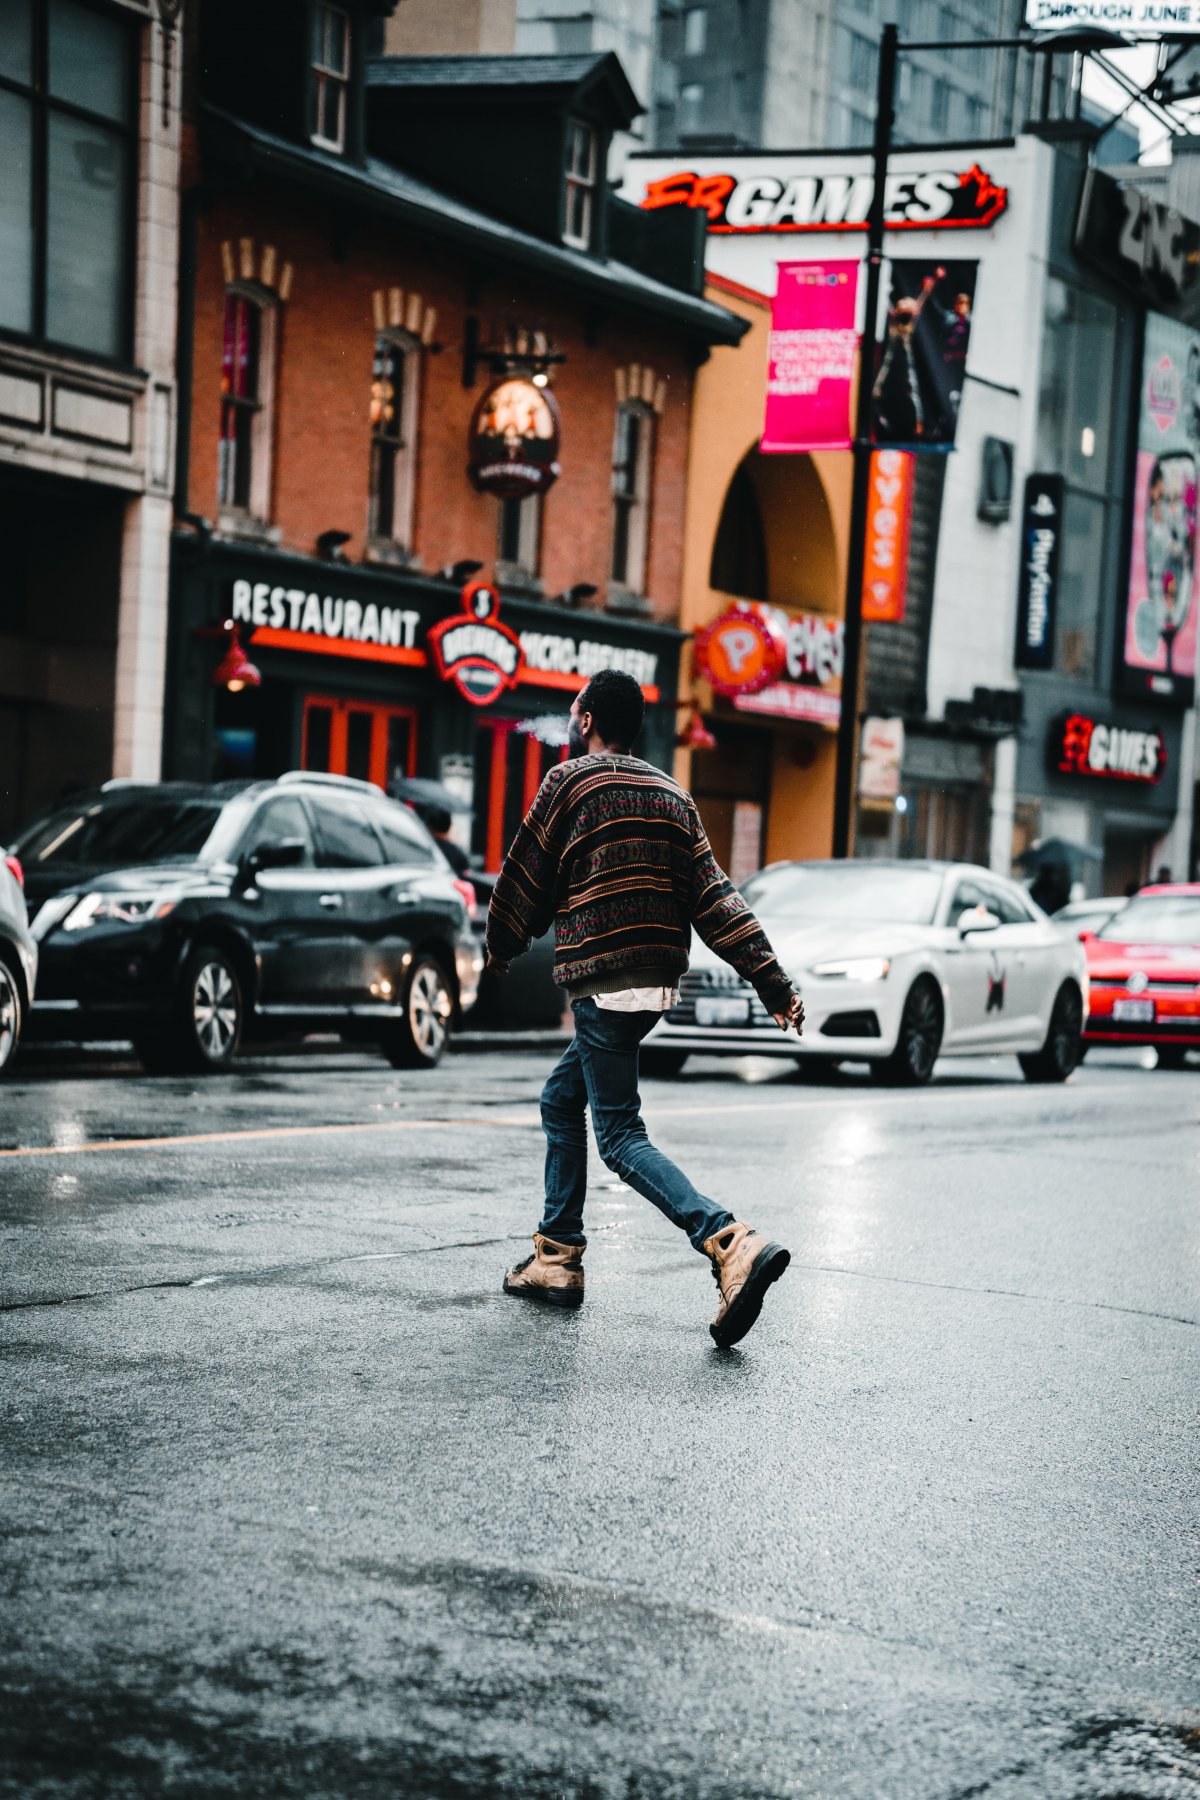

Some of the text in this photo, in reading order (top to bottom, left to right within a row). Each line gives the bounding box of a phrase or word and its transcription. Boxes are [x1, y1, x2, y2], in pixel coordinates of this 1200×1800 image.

[1037, 2, 1132, 20] THROUGH
[1140, 5, 1191, 22] JUNE
[724, 170, 962, 228] GAMES
[232, 579, 421, 650] RESTAURANT
[718, 627, 757, 673] P
[1088, 723, 1161, 778] GAMES
